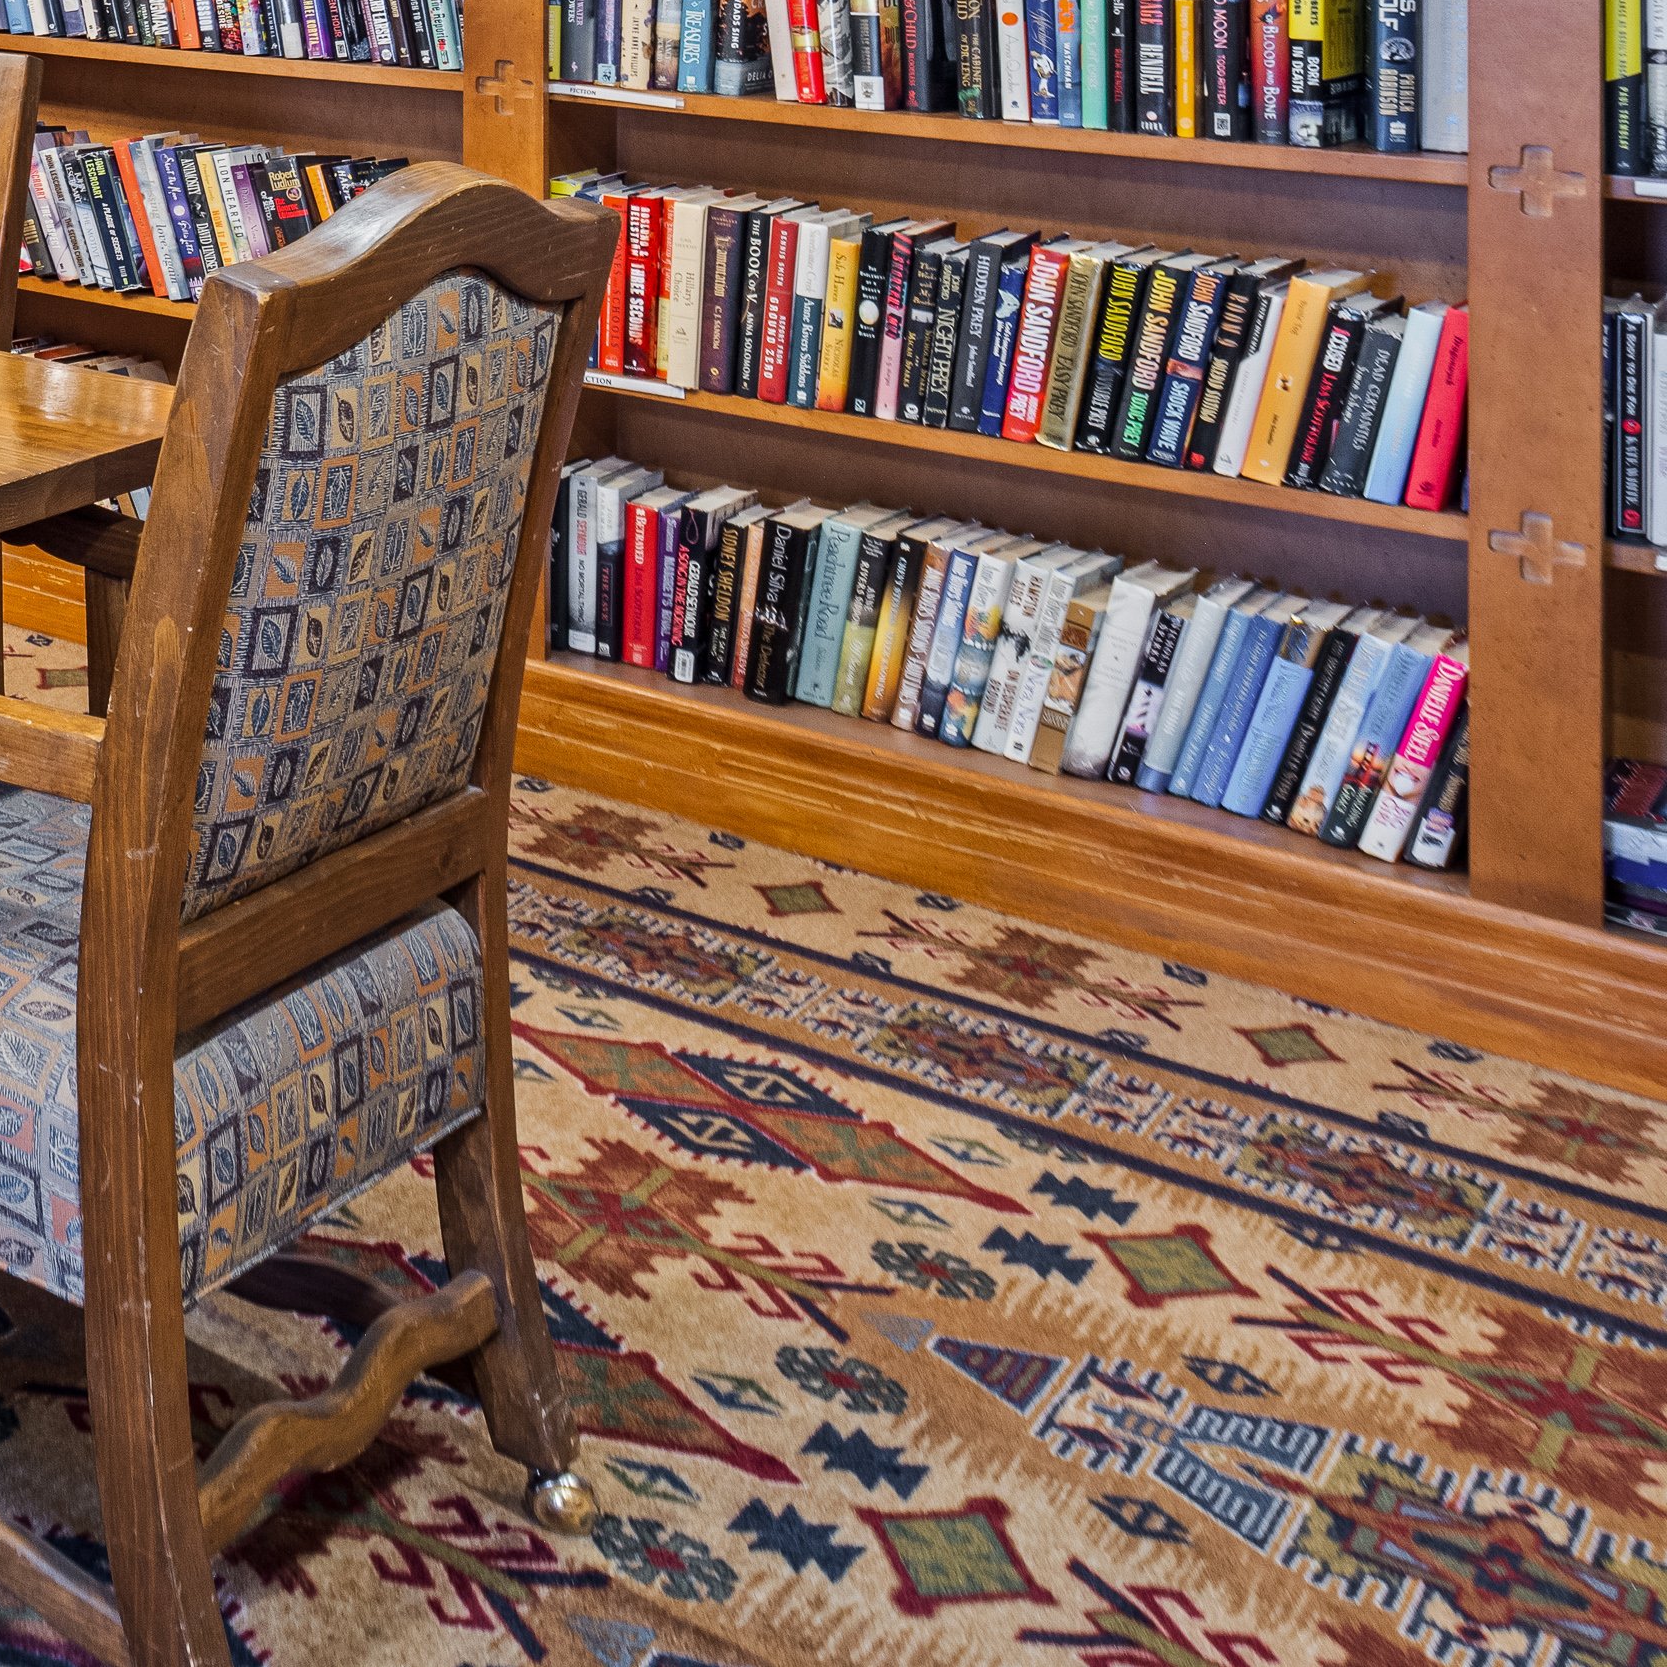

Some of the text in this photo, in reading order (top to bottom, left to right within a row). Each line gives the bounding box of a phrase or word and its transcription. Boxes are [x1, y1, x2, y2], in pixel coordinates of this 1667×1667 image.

[330, 15, 343, 38] HOUR
[683, 9, 705, 64] TREASURES
[1213, 8, 1227, 49] MOON
[1139, 44, 1164, 94] RENDELL
[1291, 46, 1303, 93] IN DEATH
[1307, 56, 1319, 86] BORN
[628, 262, 647, 346] THREE SECONDS
[763, 296, 779, 379] GROUND ZERO
[969, 254, 991, 338] HIDDEN PREY
[1013, 254, 1060, 394] JOHN SANDFORD
[797, 298, 815, 388] Anne Rivers Siddons
[930, 307, 957, 400] NIGHT PREY
[1157, 380, 1190, 452] SHOCK WAVE
[714, 527, 739, 622] SIDNEY SHELDON
[767, 524, 792, 602] Daniel Silva
[813, 529, 851, 640] Peachtree Road
[1402, 660, 1458, 763] DANIELLE STEEL
